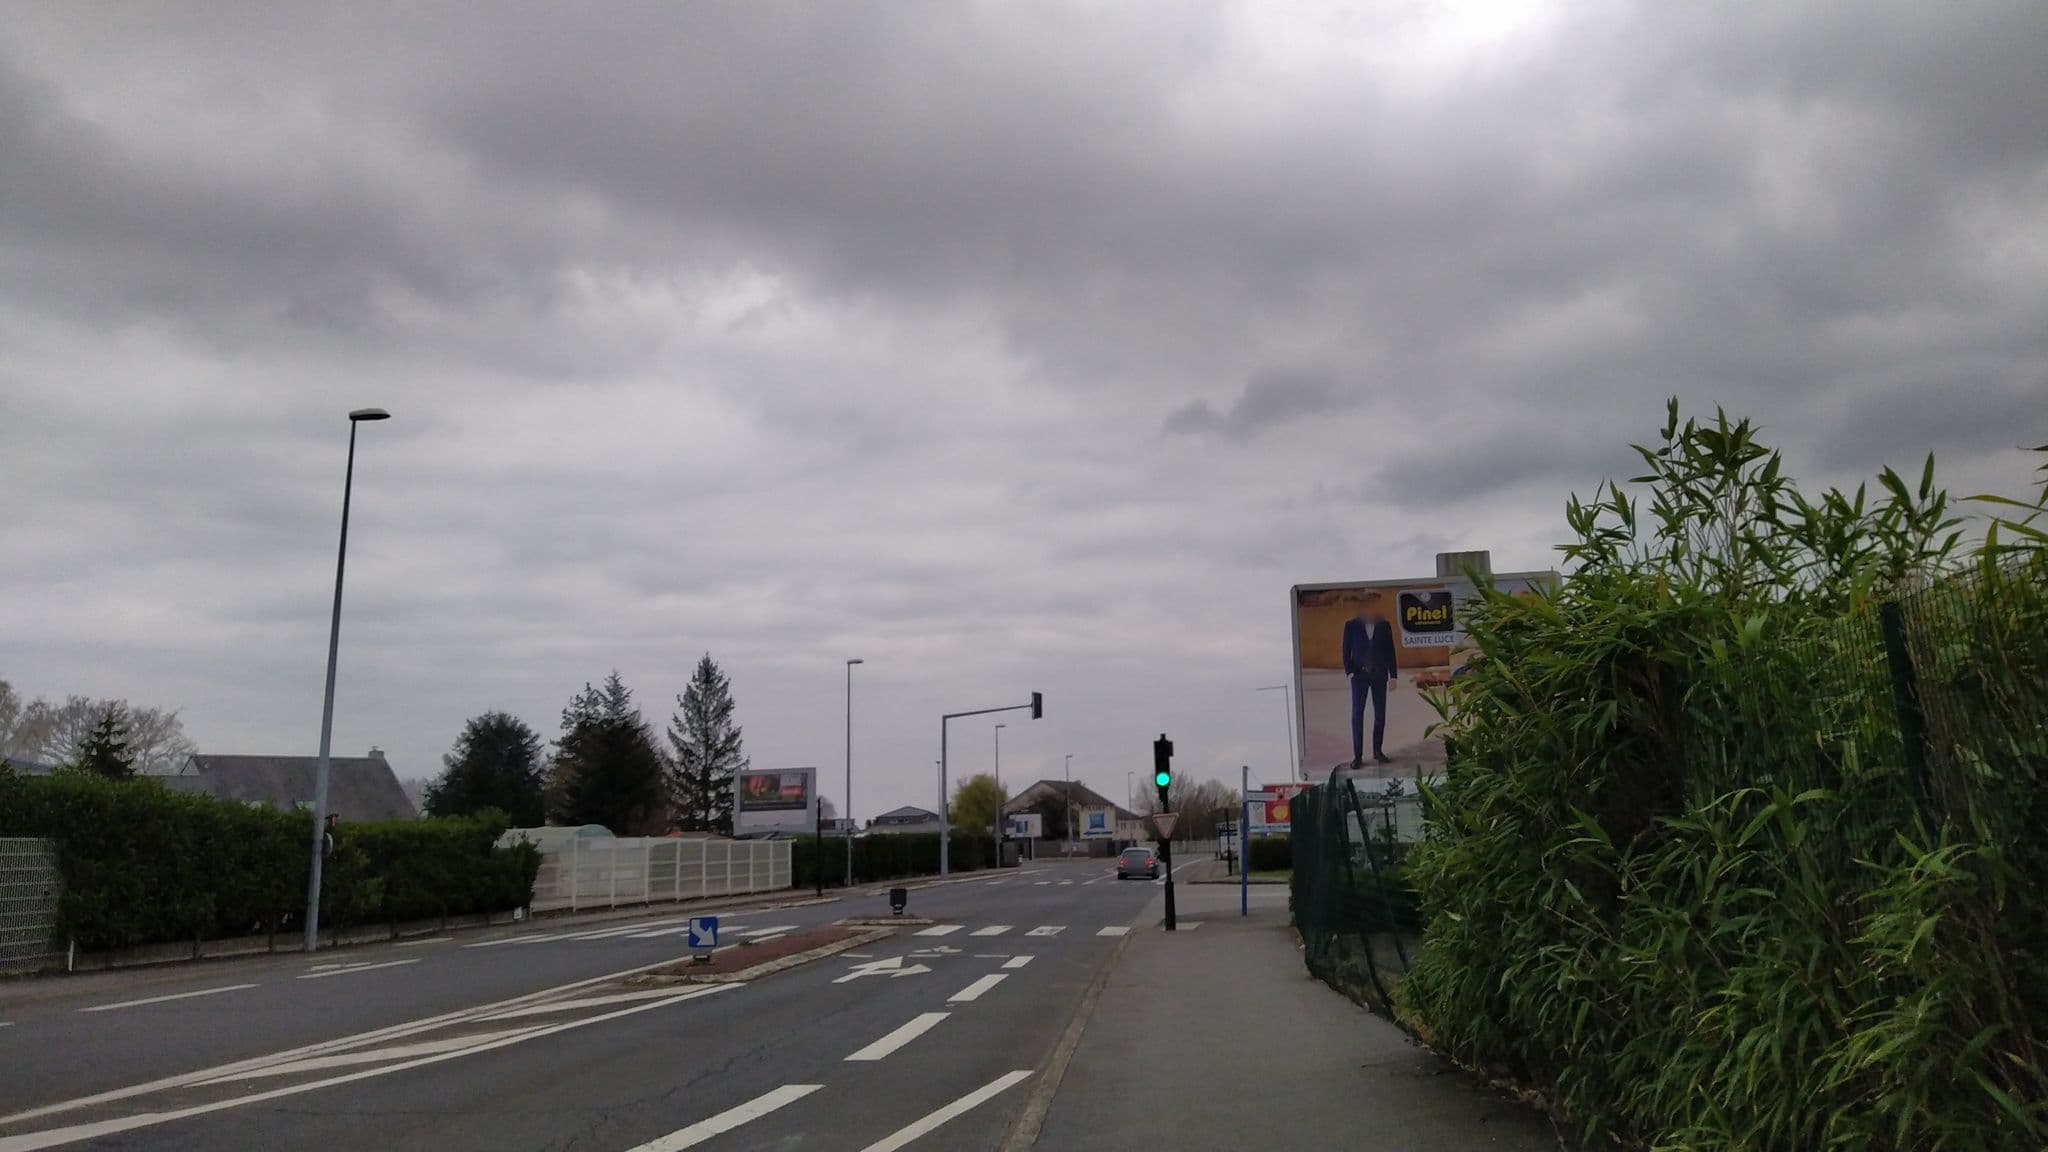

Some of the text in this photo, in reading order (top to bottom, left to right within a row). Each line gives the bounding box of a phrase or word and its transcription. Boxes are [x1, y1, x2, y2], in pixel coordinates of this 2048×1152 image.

[1407, 605, 1448, 621] Pinel
[1404, 635, 1455, 645] SAINTE LUCE
